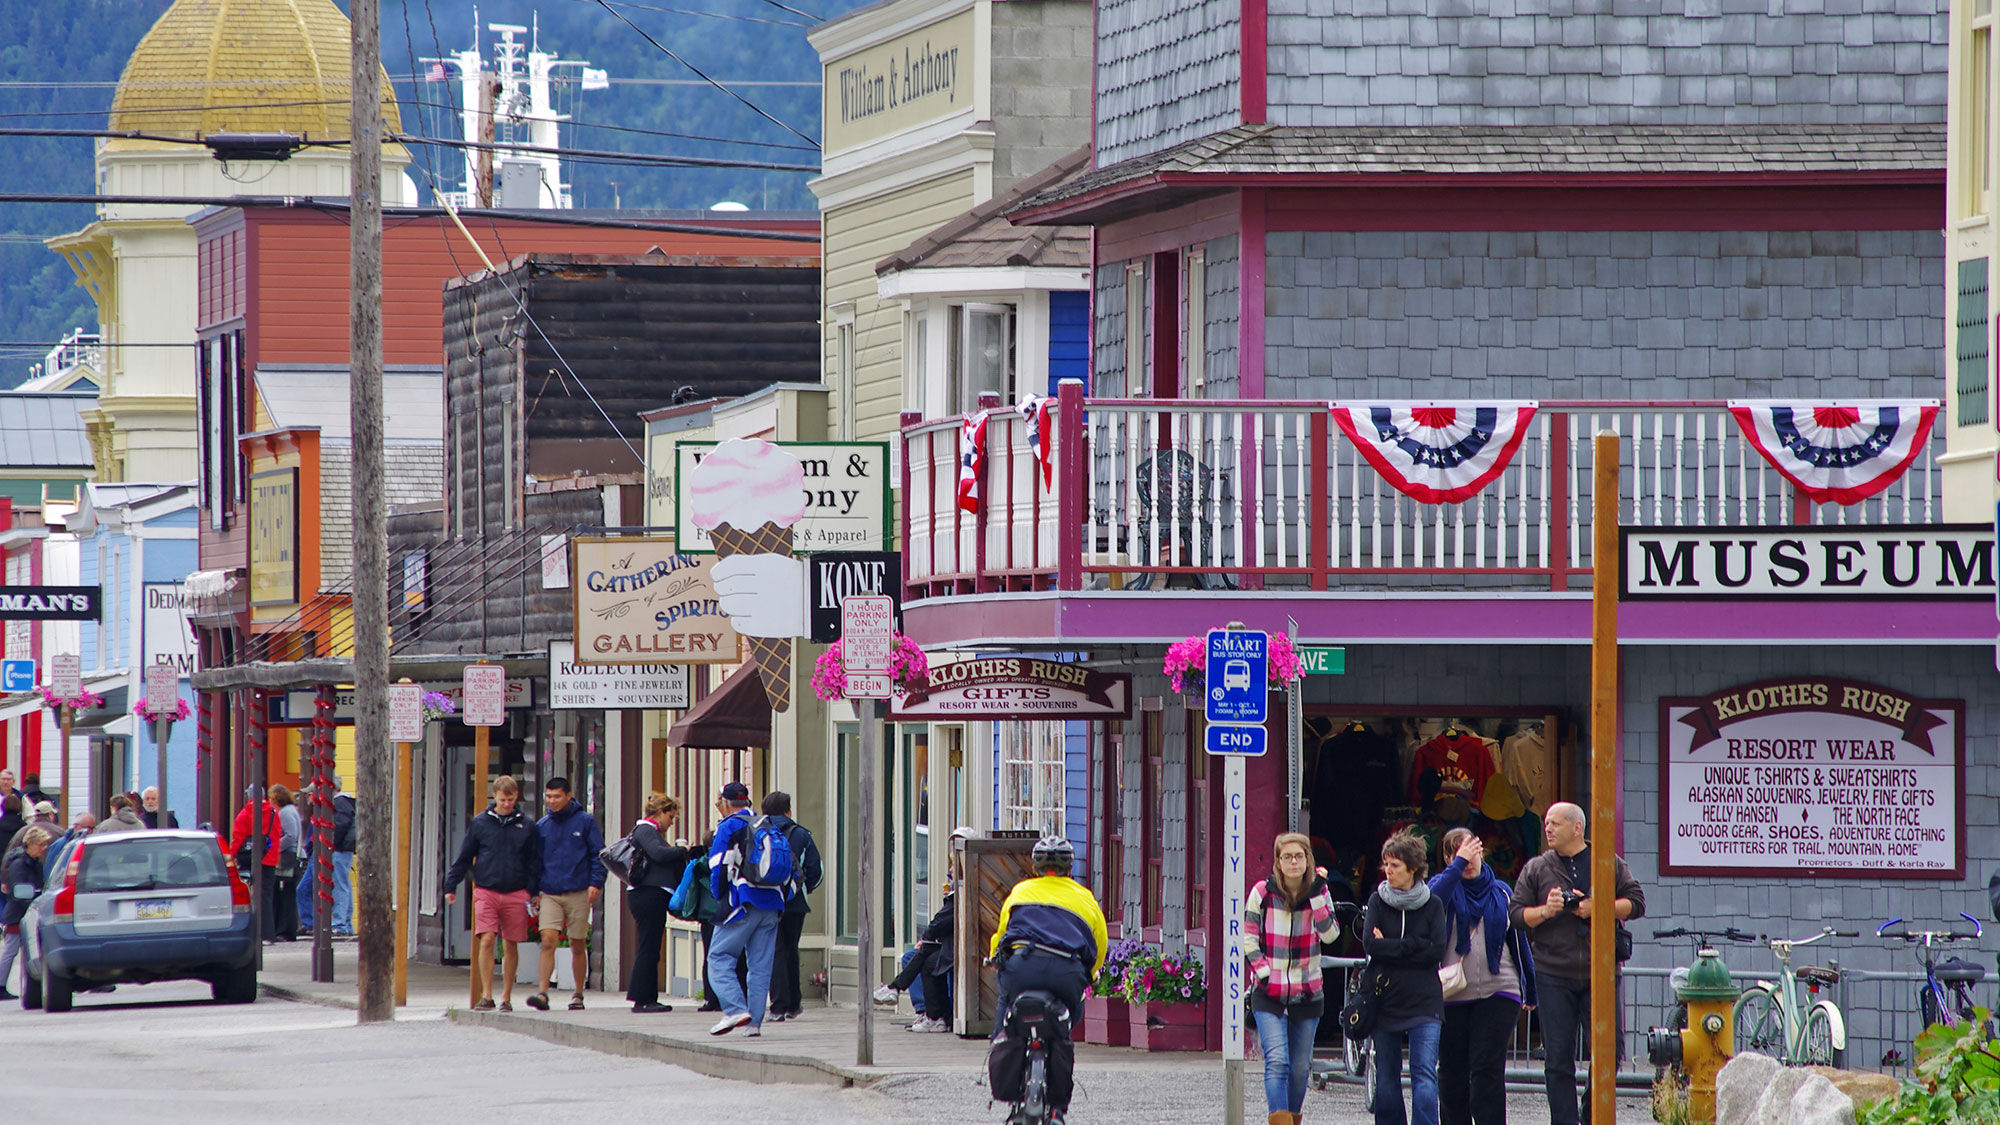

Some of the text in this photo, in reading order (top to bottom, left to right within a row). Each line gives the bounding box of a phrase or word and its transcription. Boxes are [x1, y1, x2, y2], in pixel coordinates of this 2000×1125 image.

[840, 40, 958, 124] William & Anthony
[845, 453, 870, 478] &
[818, 530, 867, 544] Apparel
[1639, 539, 1996, 587] MUSEUM
[587, 554, 701, 593] GATHERING
[593, 633, 724, 653] GALLERY
[1213, 638, 1262, 651] SMART
[1300, 652, 1328, 670] AVE
[11, 671, 32, 679] Phone
[929, 659, 1089, 687] KLOTHES RUSH
[554, 680, 683, 690] 14K GOLD FINE JEWELRY
[853, 681, 882, 691] BEGIN
[947, 680, 972, 689] LOCALLY
[554, 694, 684, 704] T-SHIRTS SOUVENIERS
[962, 688, 1051, 700] GIFTS
[1713, 684, 1911, 722] KLOTHES RUSH
[939, 701, 1078, 710] RESORT WEAR SOUVENIRS
[1220, 733, 1252, 746] END
[1727, 739, 1897, 761] RESORT WEAR
[1704, 767, 1917, 787] UNIQUE T-SHIRTS & SWEATSHIRTS
[1688, 786, 1743, 803] ALASKAN
[1873, 789, 1898, 806] FINE
[1902, 790, 1934, 806] GIFTS
[1702, 805, 1920, 826] HELLY HANSEN THE NORTH FACE
[1677, 824, 1728, 838] OUTDOOR
[1829, 827, 1891, 841] ADVENTURE
[1894, 828, 1945, 842] CLOTHING
[1768, 841, 1788, 855] FOR
[1798, 859, 1853, 867] Proprietors
[1229, 793, 1240, 1042] CITY TRANSIT
